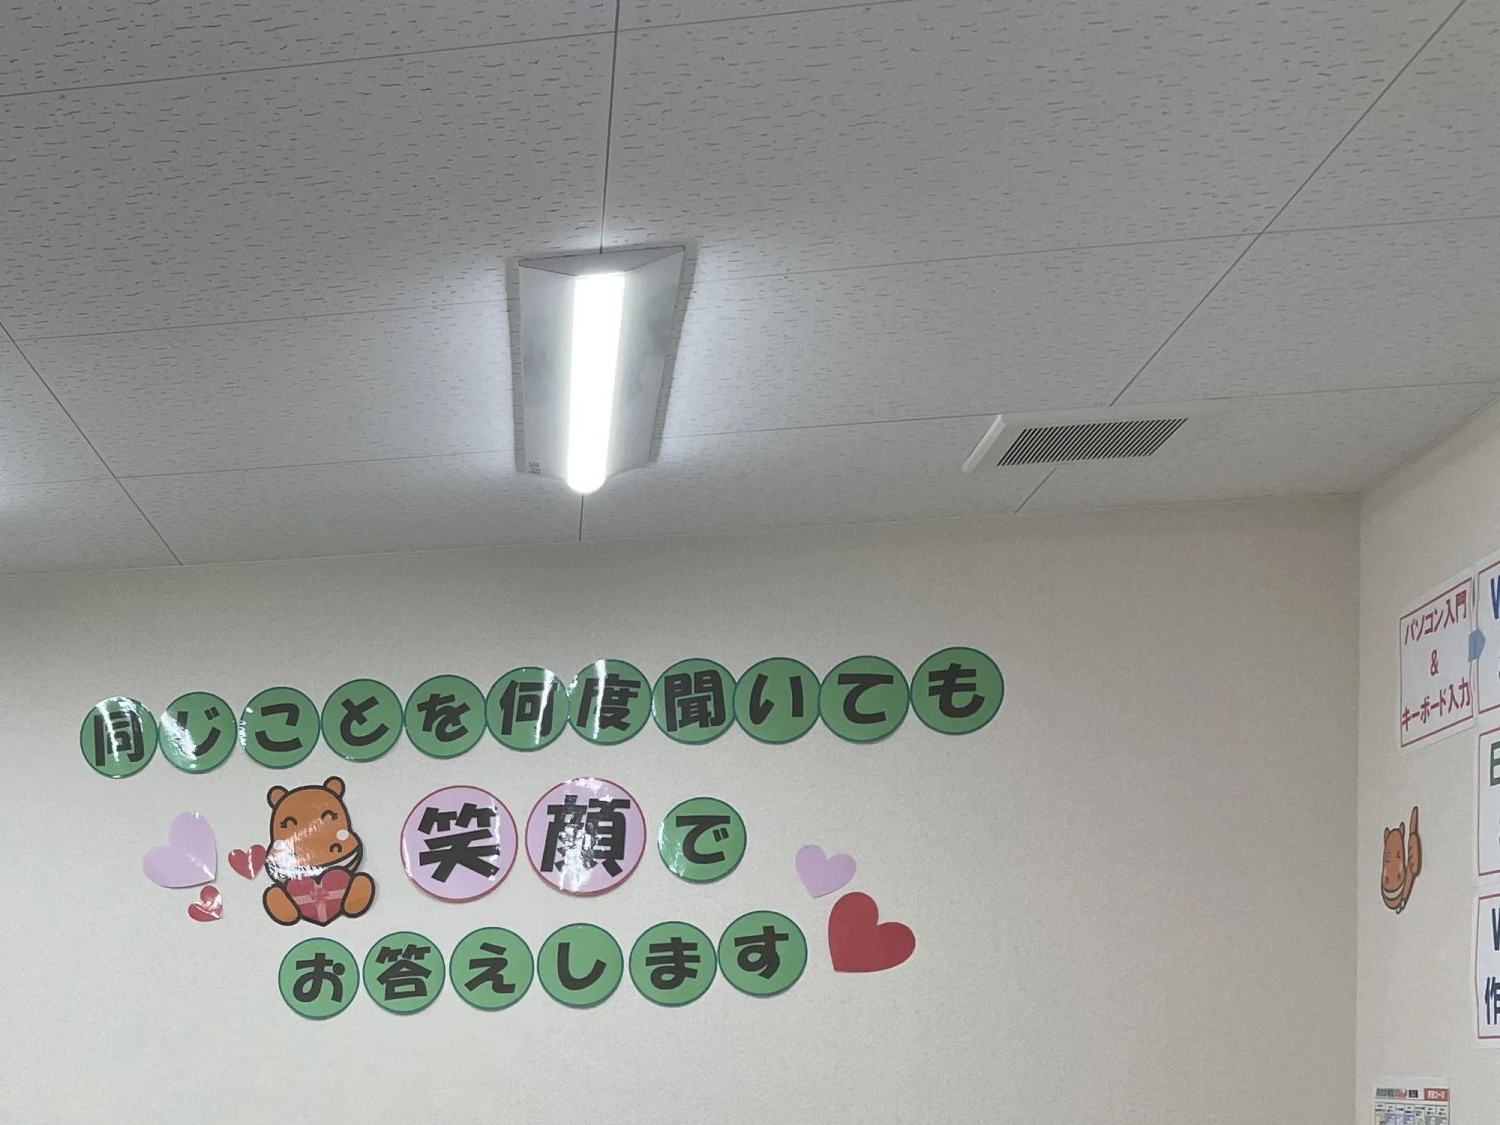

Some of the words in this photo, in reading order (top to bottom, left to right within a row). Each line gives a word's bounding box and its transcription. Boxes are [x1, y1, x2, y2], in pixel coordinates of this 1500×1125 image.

[1405, 589, 1467, 645] パソコン入門
[1430, 649, 1439, 676] &
[94, 662, 984, 767] 同じことを何度聞いても
[1401, 677, 1470, 731] キーボード入力
[417, 794, 742, 881] 笑顔で
[294, 922, 791, 1004] お答えします
